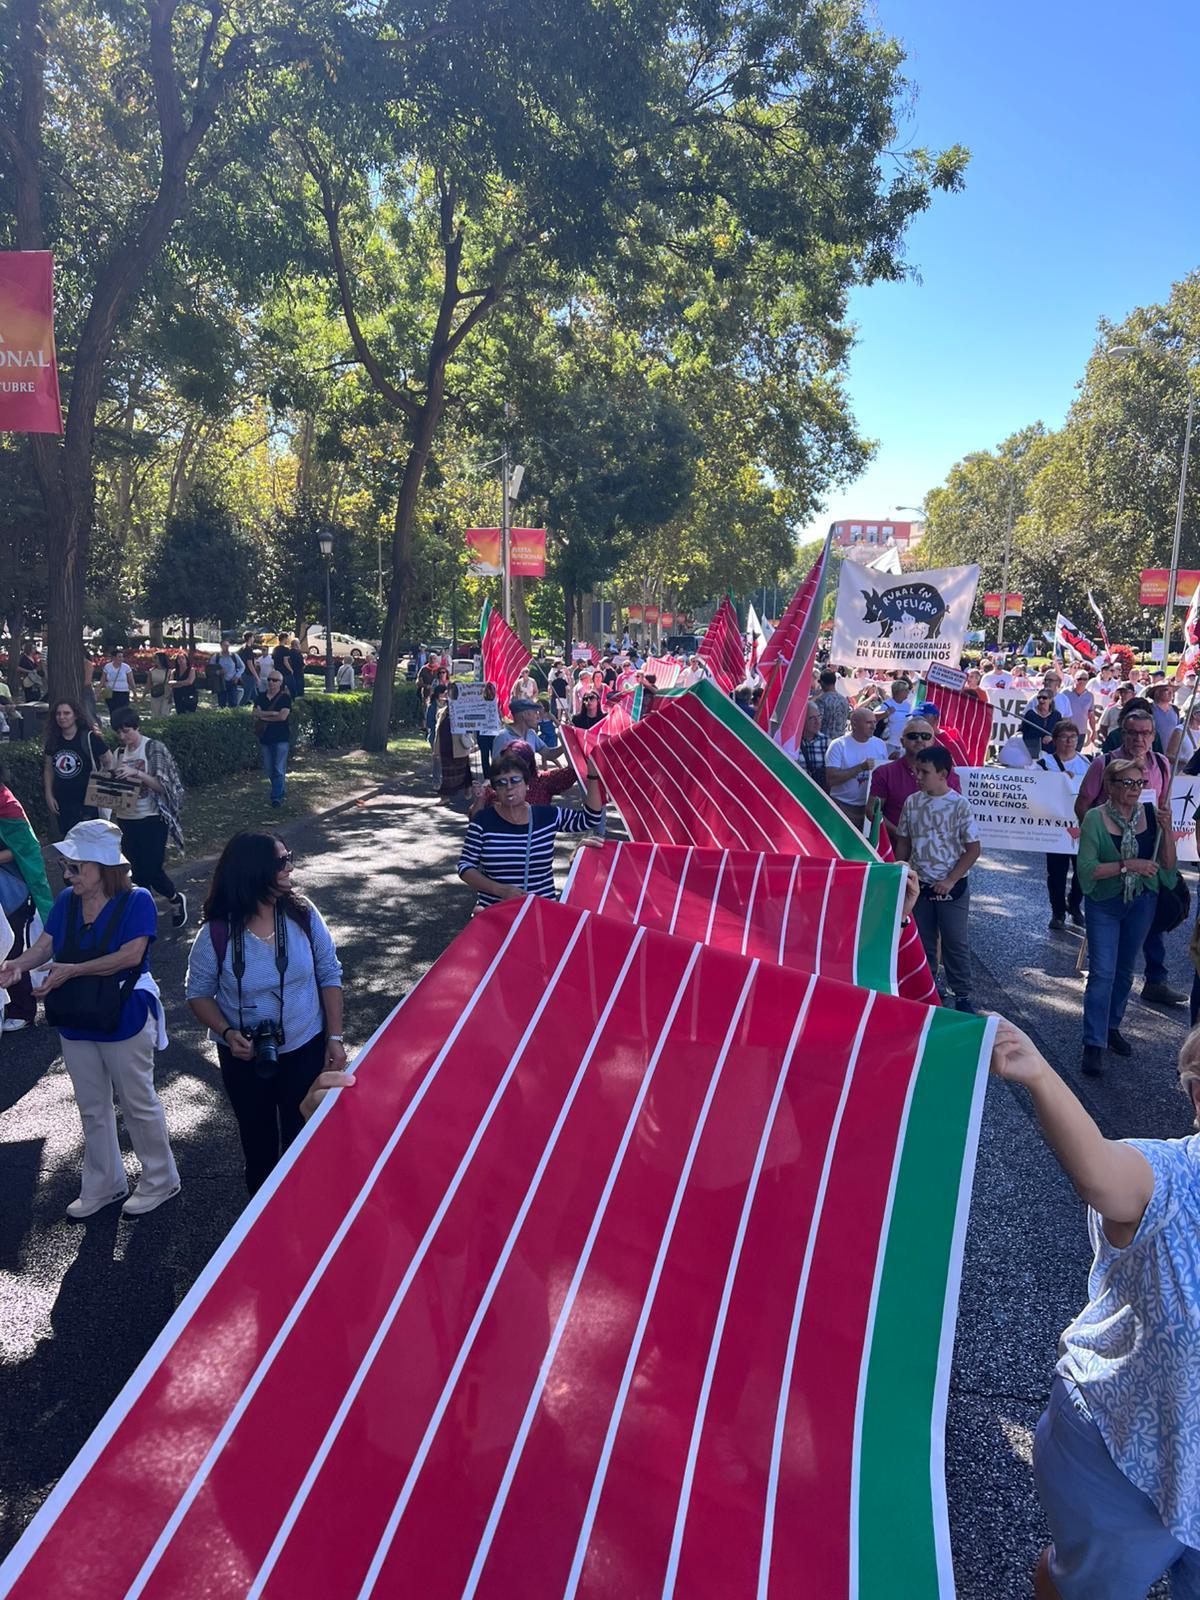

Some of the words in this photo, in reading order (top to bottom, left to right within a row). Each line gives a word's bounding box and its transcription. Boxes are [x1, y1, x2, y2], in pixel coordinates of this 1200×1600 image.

[0, 381, 36, 393] UBRE
[883, 587, 914, 606] RURAL
[918, 587, 932, 598] EN
[896, 599, 938, 615] PELIGRO
[878, 641, 891, 649] LAS
[893, 642, 951, 650] MACROGRANJAS
[856, 648, 869, 657] EN
[872, 649, 951, 660] FUENTEMOLINOS
[969, 772, 979, 780] NI
[1002, 775, 1037, 784] CABLES,
[968, 789, 979, 797] LO
[981, 790, 1000, 798] QUE
[1002, 792, 1028, 800] FALTA
[997, 815, 1017, 824] VEZ
[1020, 817, 1034, 825] NO
[1038, 818, 1051, 827] EN
[1055, 819, 1079, 828] SAY
